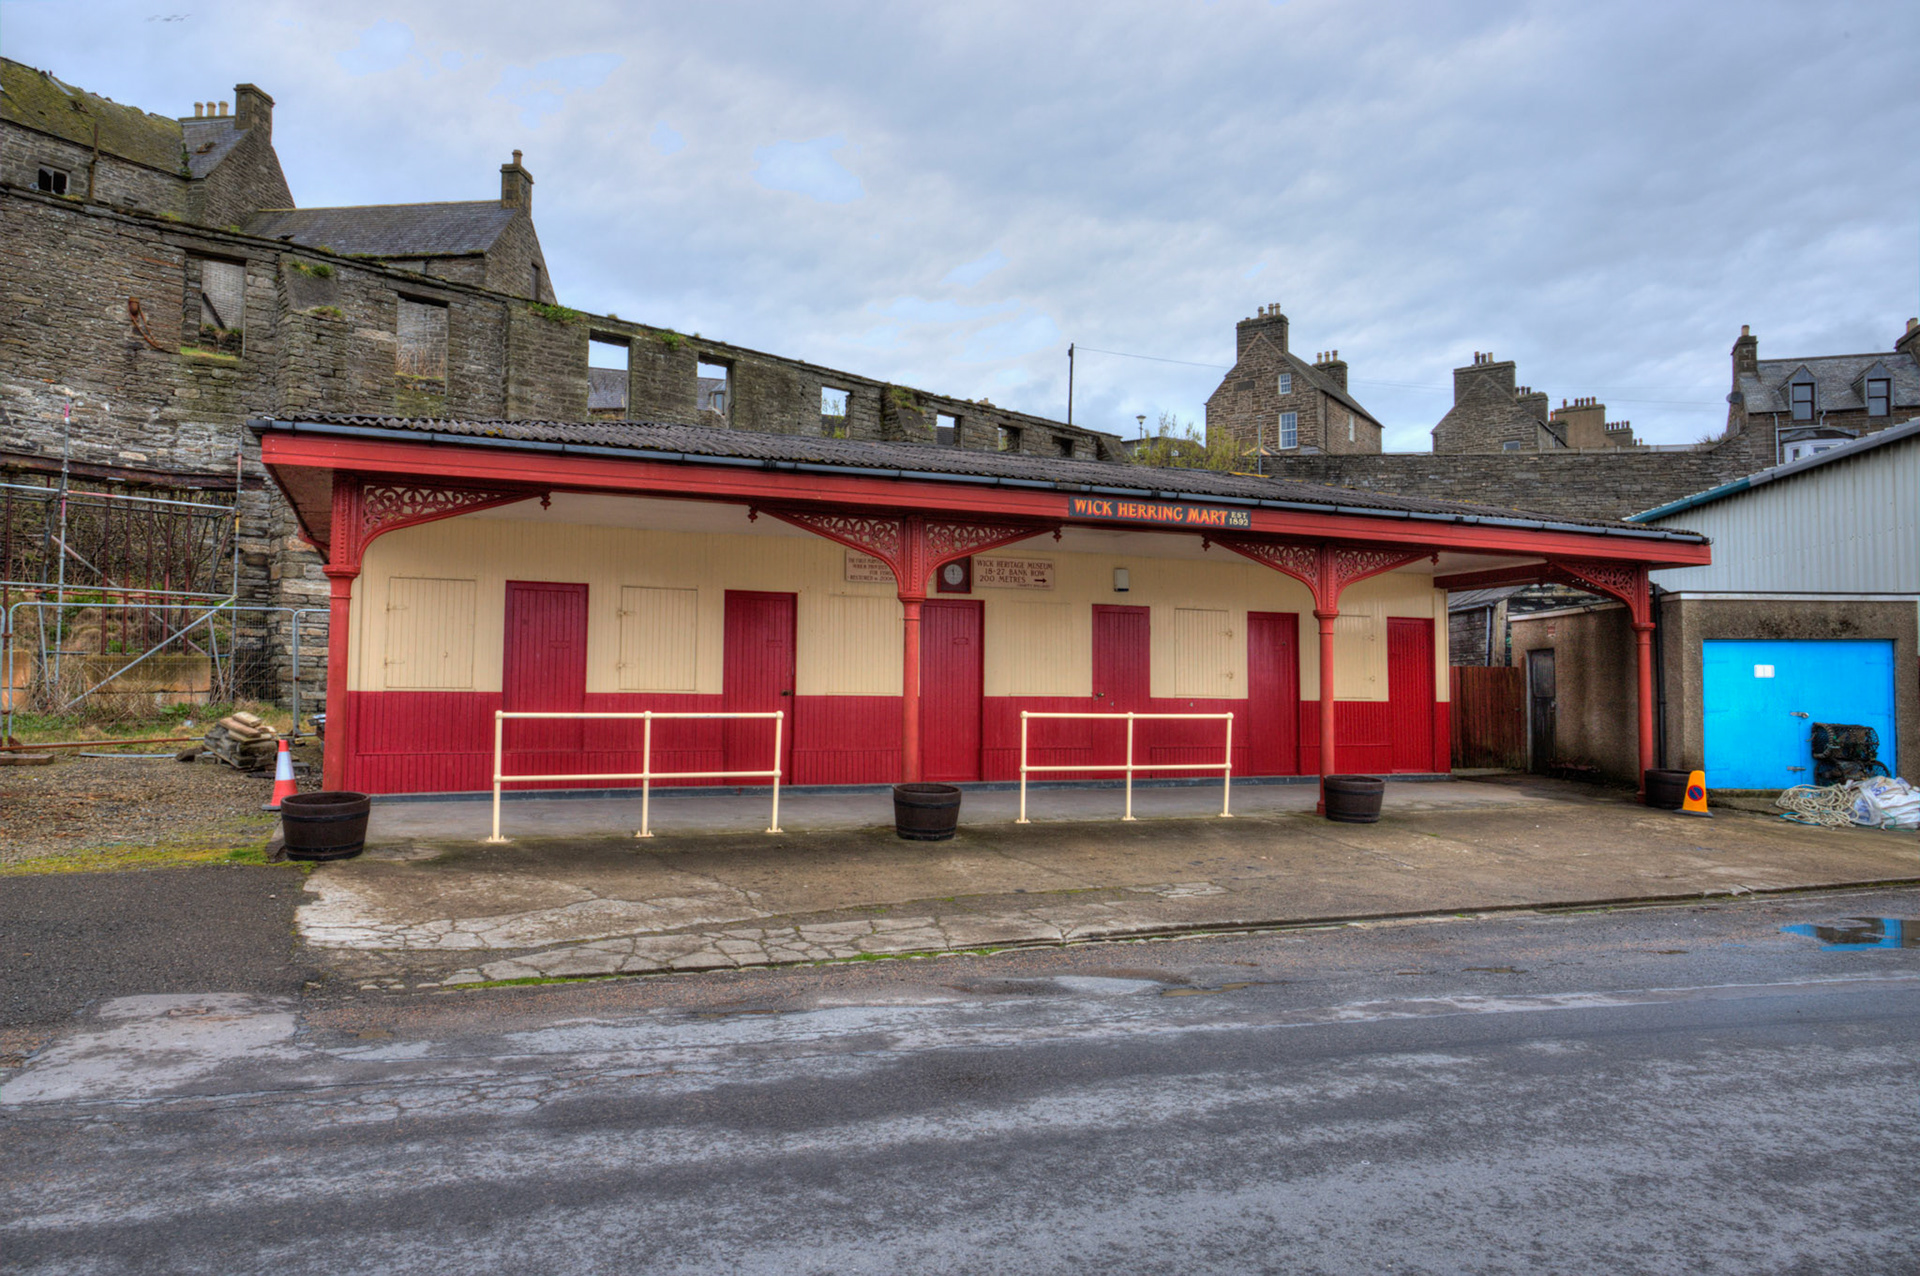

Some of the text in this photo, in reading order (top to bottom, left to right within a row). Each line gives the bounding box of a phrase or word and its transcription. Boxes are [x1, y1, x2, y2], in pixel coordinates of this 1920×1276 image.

[1074, 499, 1228, 525] WICK HERRING MART
[1229, 518, 1249, 526] 1892
[976, 559, 1053, 570] WICK HERITAGE MUSEUM
[1009, 568, 1028, 576] BANK
[998, 575, 1026, 583] METRES
